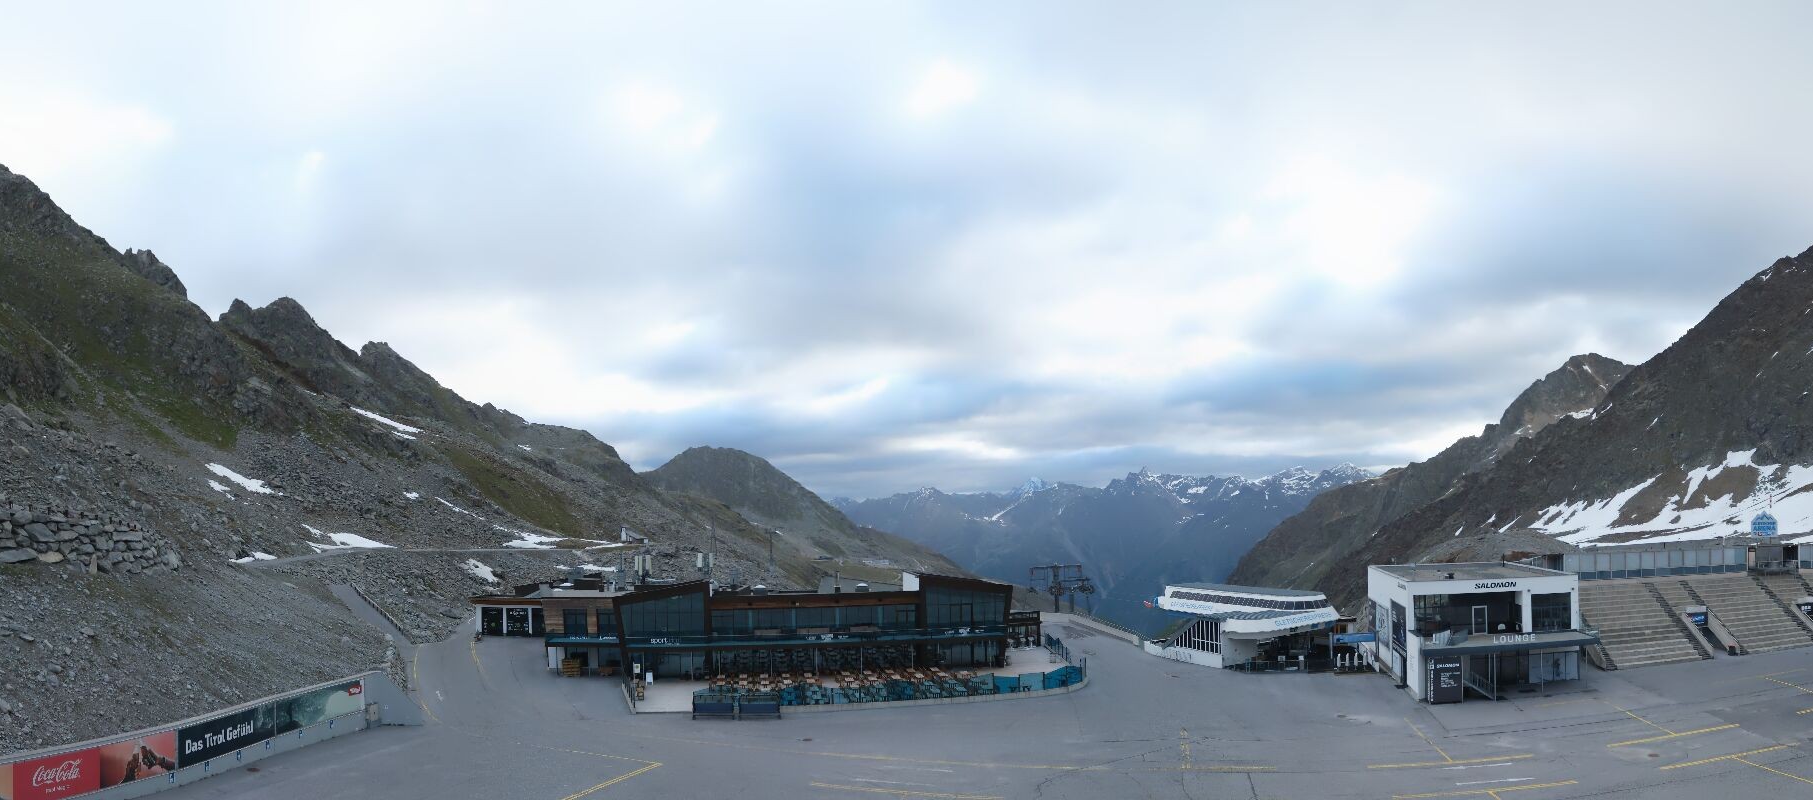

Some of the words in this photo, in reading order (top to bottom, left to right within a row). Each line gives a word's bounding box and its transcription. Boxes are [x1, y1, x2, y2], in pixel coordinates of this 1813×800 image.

[1474, 581, 1517, 589] SALOMON
[1493, 633, 1536, 644] LOUNGE
[185, 739, 203, 755] Das
[204, 730, 225, 749] Tirol
[226, 720, 254, 741] Gefühl
